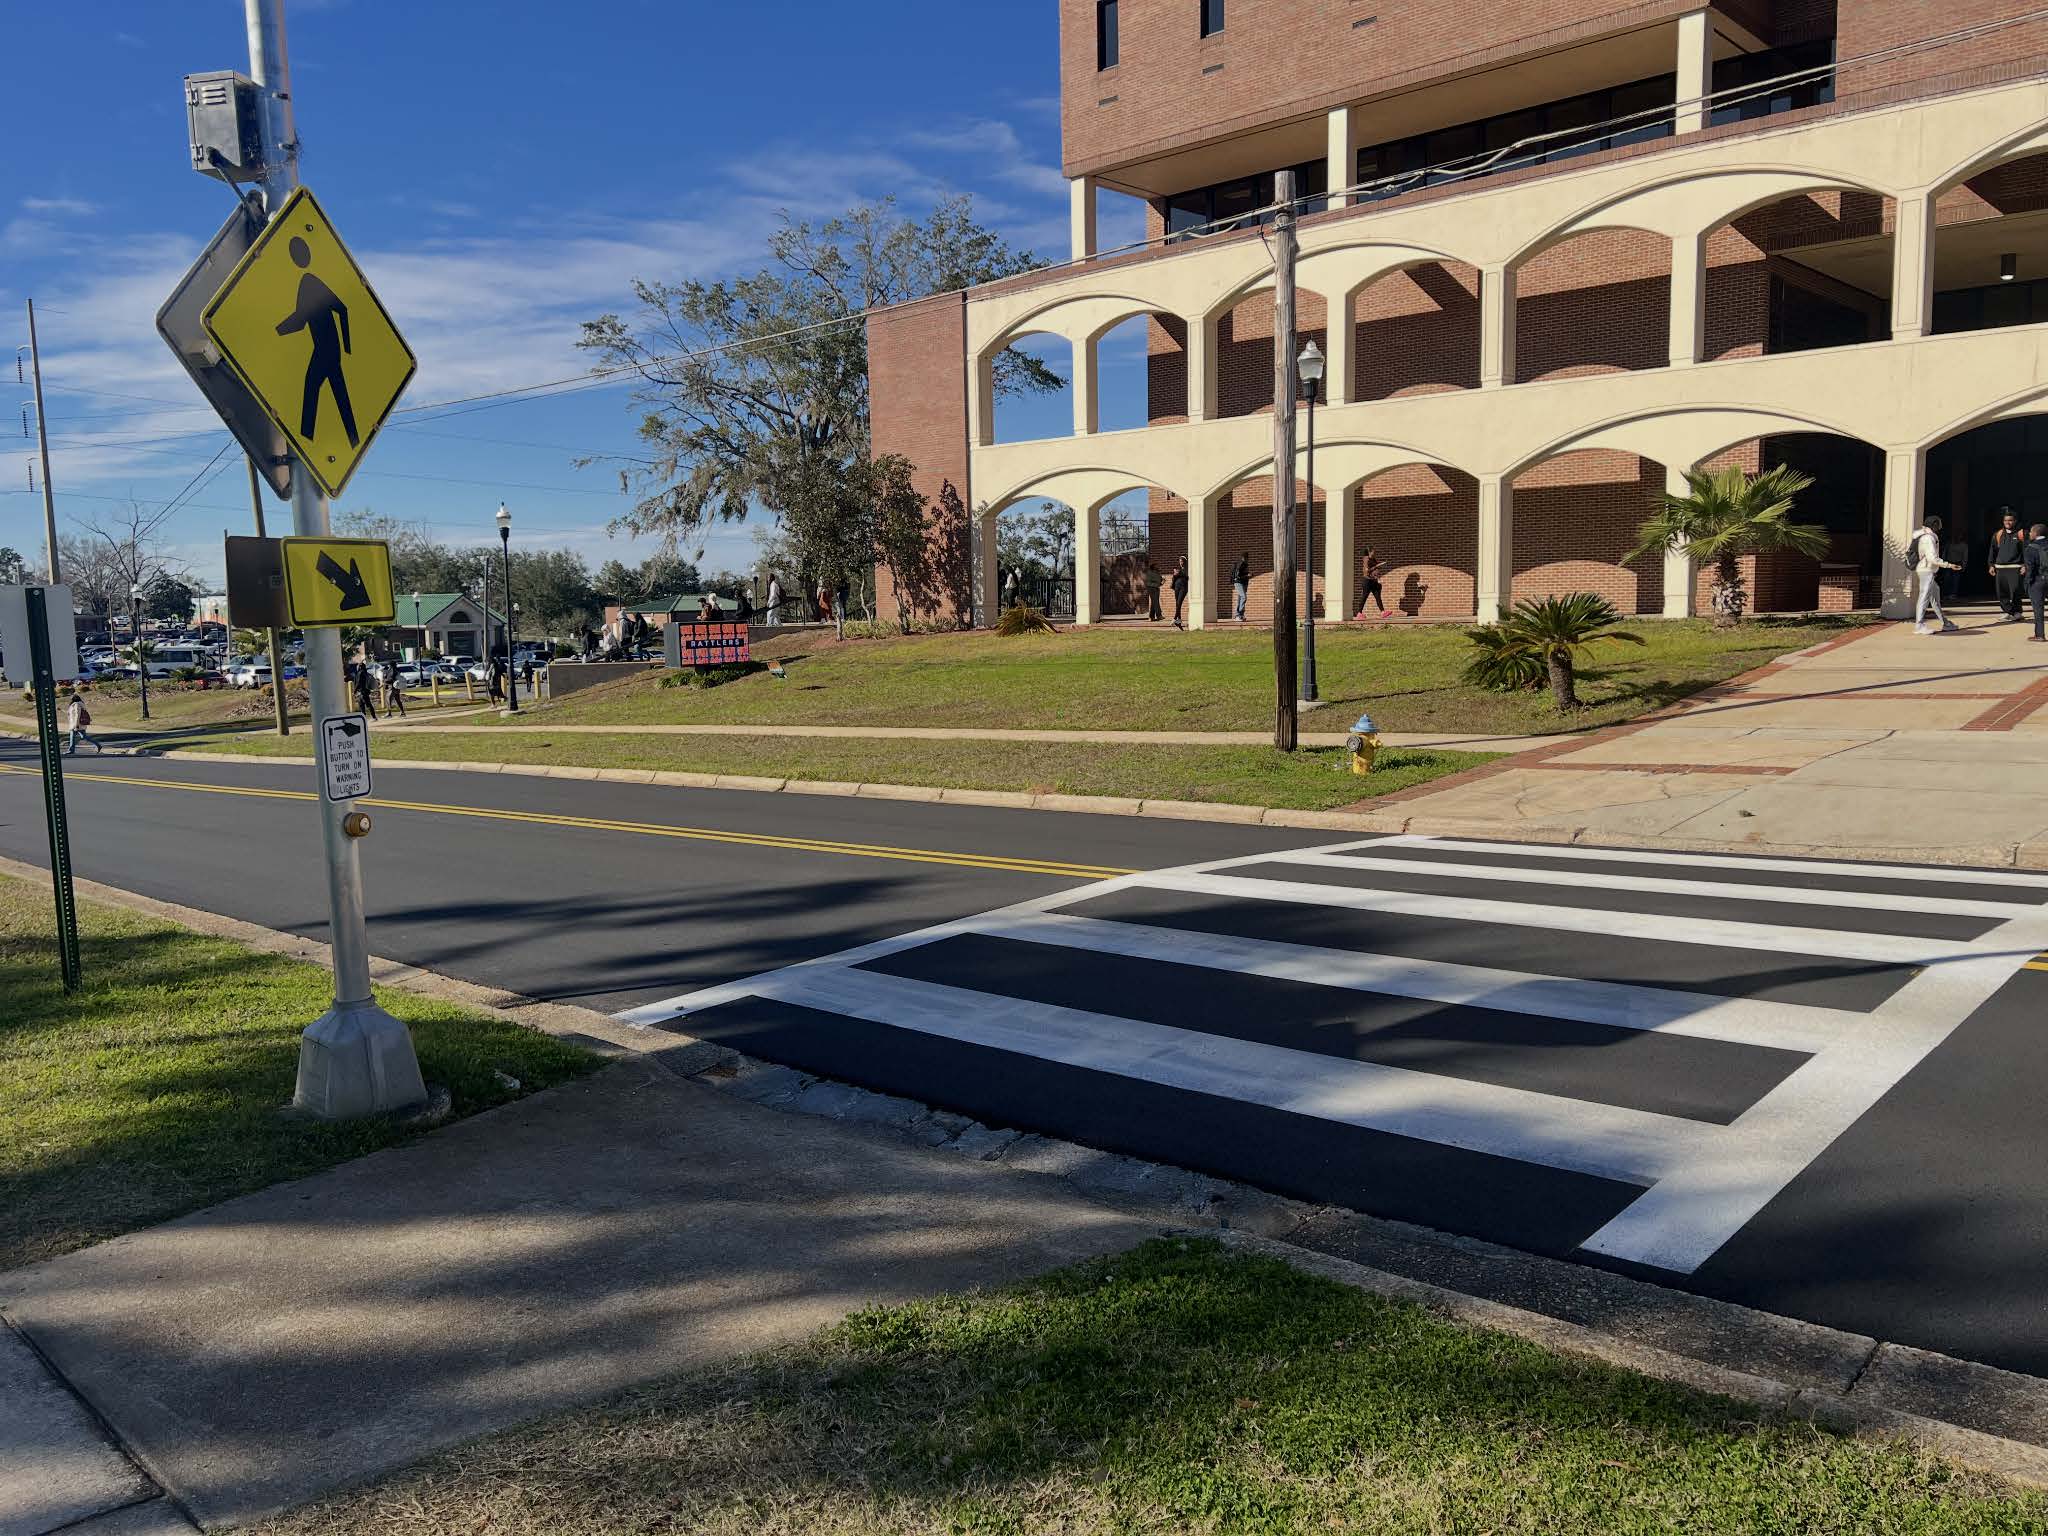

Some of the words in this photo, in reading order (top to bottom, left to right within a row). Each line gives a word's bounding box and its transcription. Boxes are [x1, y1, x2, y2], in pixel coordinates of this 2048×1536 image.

[690, 639, 740, 647] RATTLERS
[338, 741, 354, 750] PUSH
[330, 752, 352, 762] BUTTON
[334, 764, 350, 772] TURN
[336, 772, 362, 782] WARNING
[340, 783, 360, 794] LIGHTS
